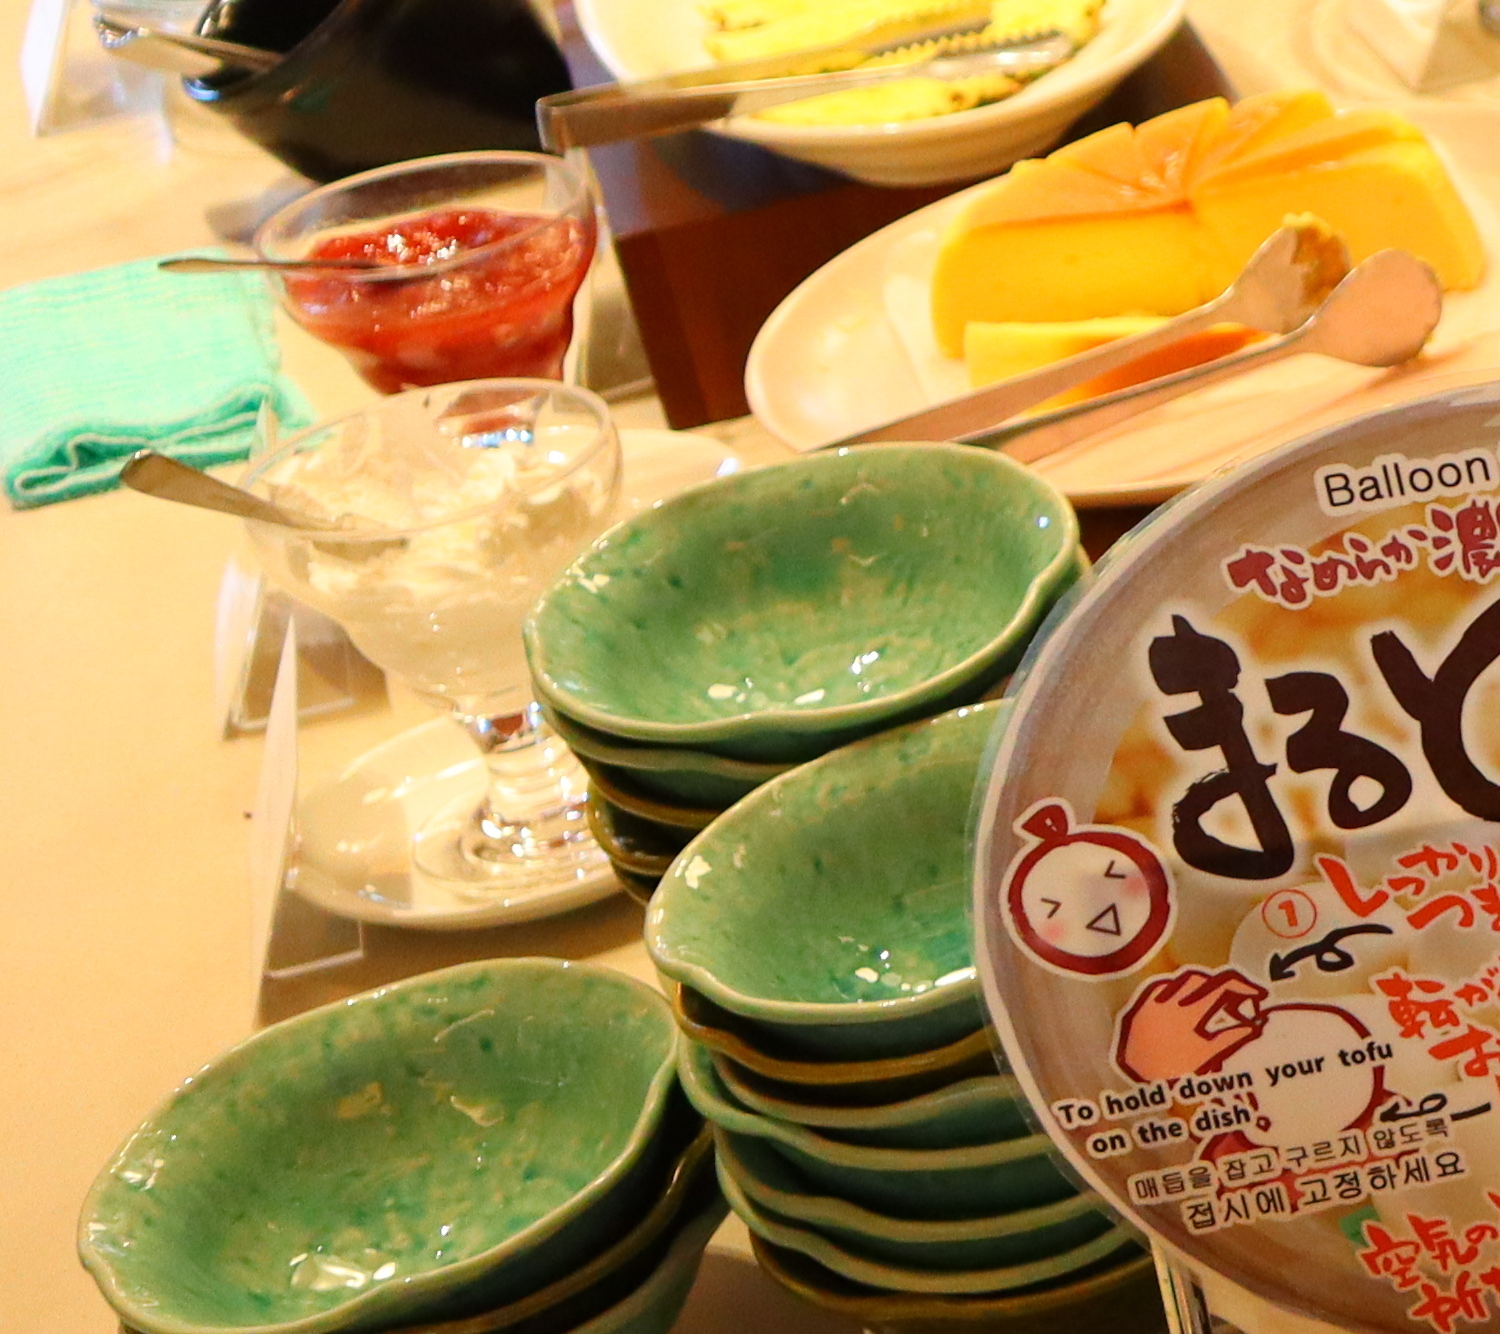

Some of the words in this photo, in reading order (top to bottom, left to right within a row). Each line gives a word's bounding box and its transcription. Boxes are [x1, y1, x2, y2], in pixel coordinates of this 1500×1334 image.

[1325, 453, 1490, 509] Balloon
[1319, 842, 1498, 918] しっかり
[1060, 1102, 1095, 1127] To
[1105, 1083, 1166, 1117] hold
[1179, 1069, 1253, 1101] down
[1266, 1056, 1325, 1087] your
[1337, 1038, 1394, 1067] tofu
[1091, 1128, 1127, 1154] on
[1136, 1117, 1183, 1145] the
[1135, 1166, 1207, 1202] 매듭을
[1222, 1153, 1276, 1183] 잡고
[1286, 1135, 1363, 1169] 구르지
[1372, 1114, 1451, 1153] 않도록
[1187, 1193, 1287, 1231] 접시에
[1300, 1150, 1466, 1206] 고정하세요
